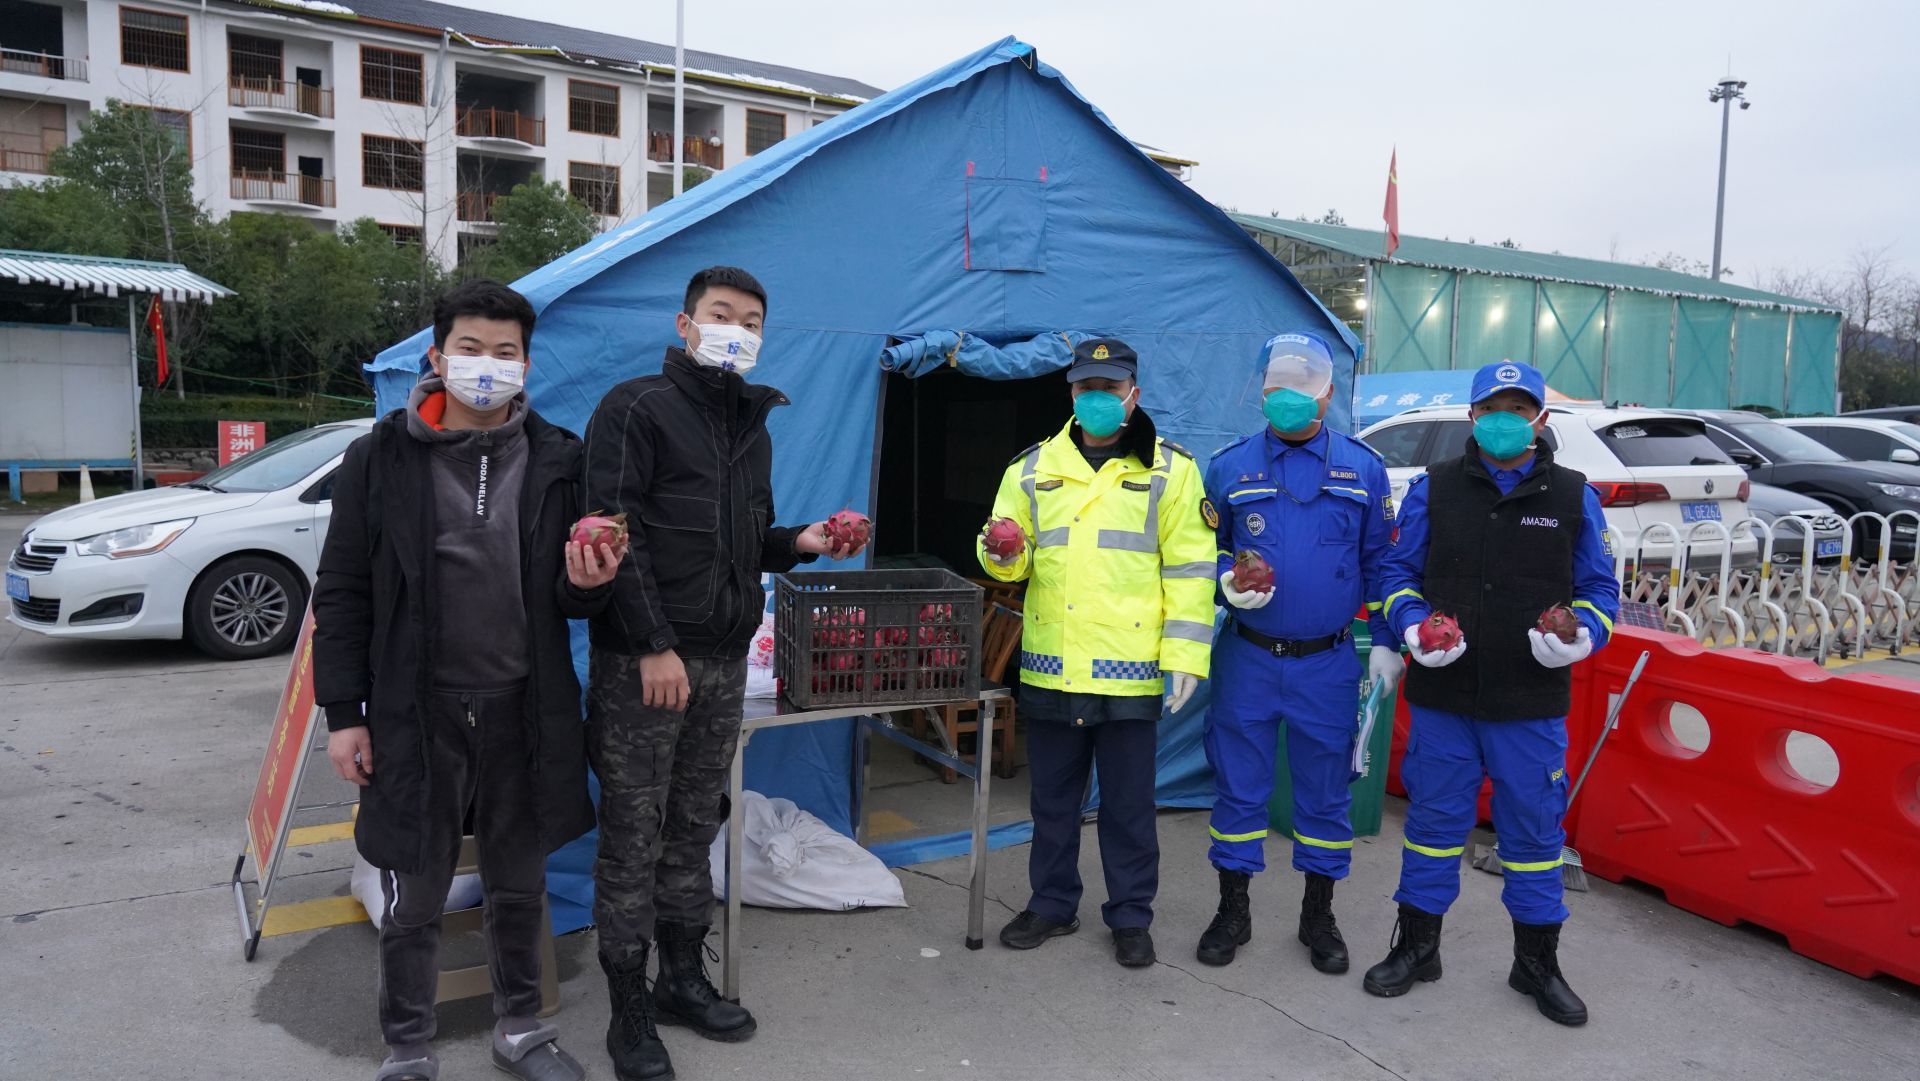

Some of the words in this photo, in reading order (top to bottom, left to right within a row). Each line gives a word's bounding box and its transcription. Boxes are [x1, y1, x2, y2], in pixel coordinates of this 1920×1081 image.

[480, 455, 488, 482] MODA
[476, 483, 487, 516] NELLAV
[1520, 516, 1559, 528] AMAZING
